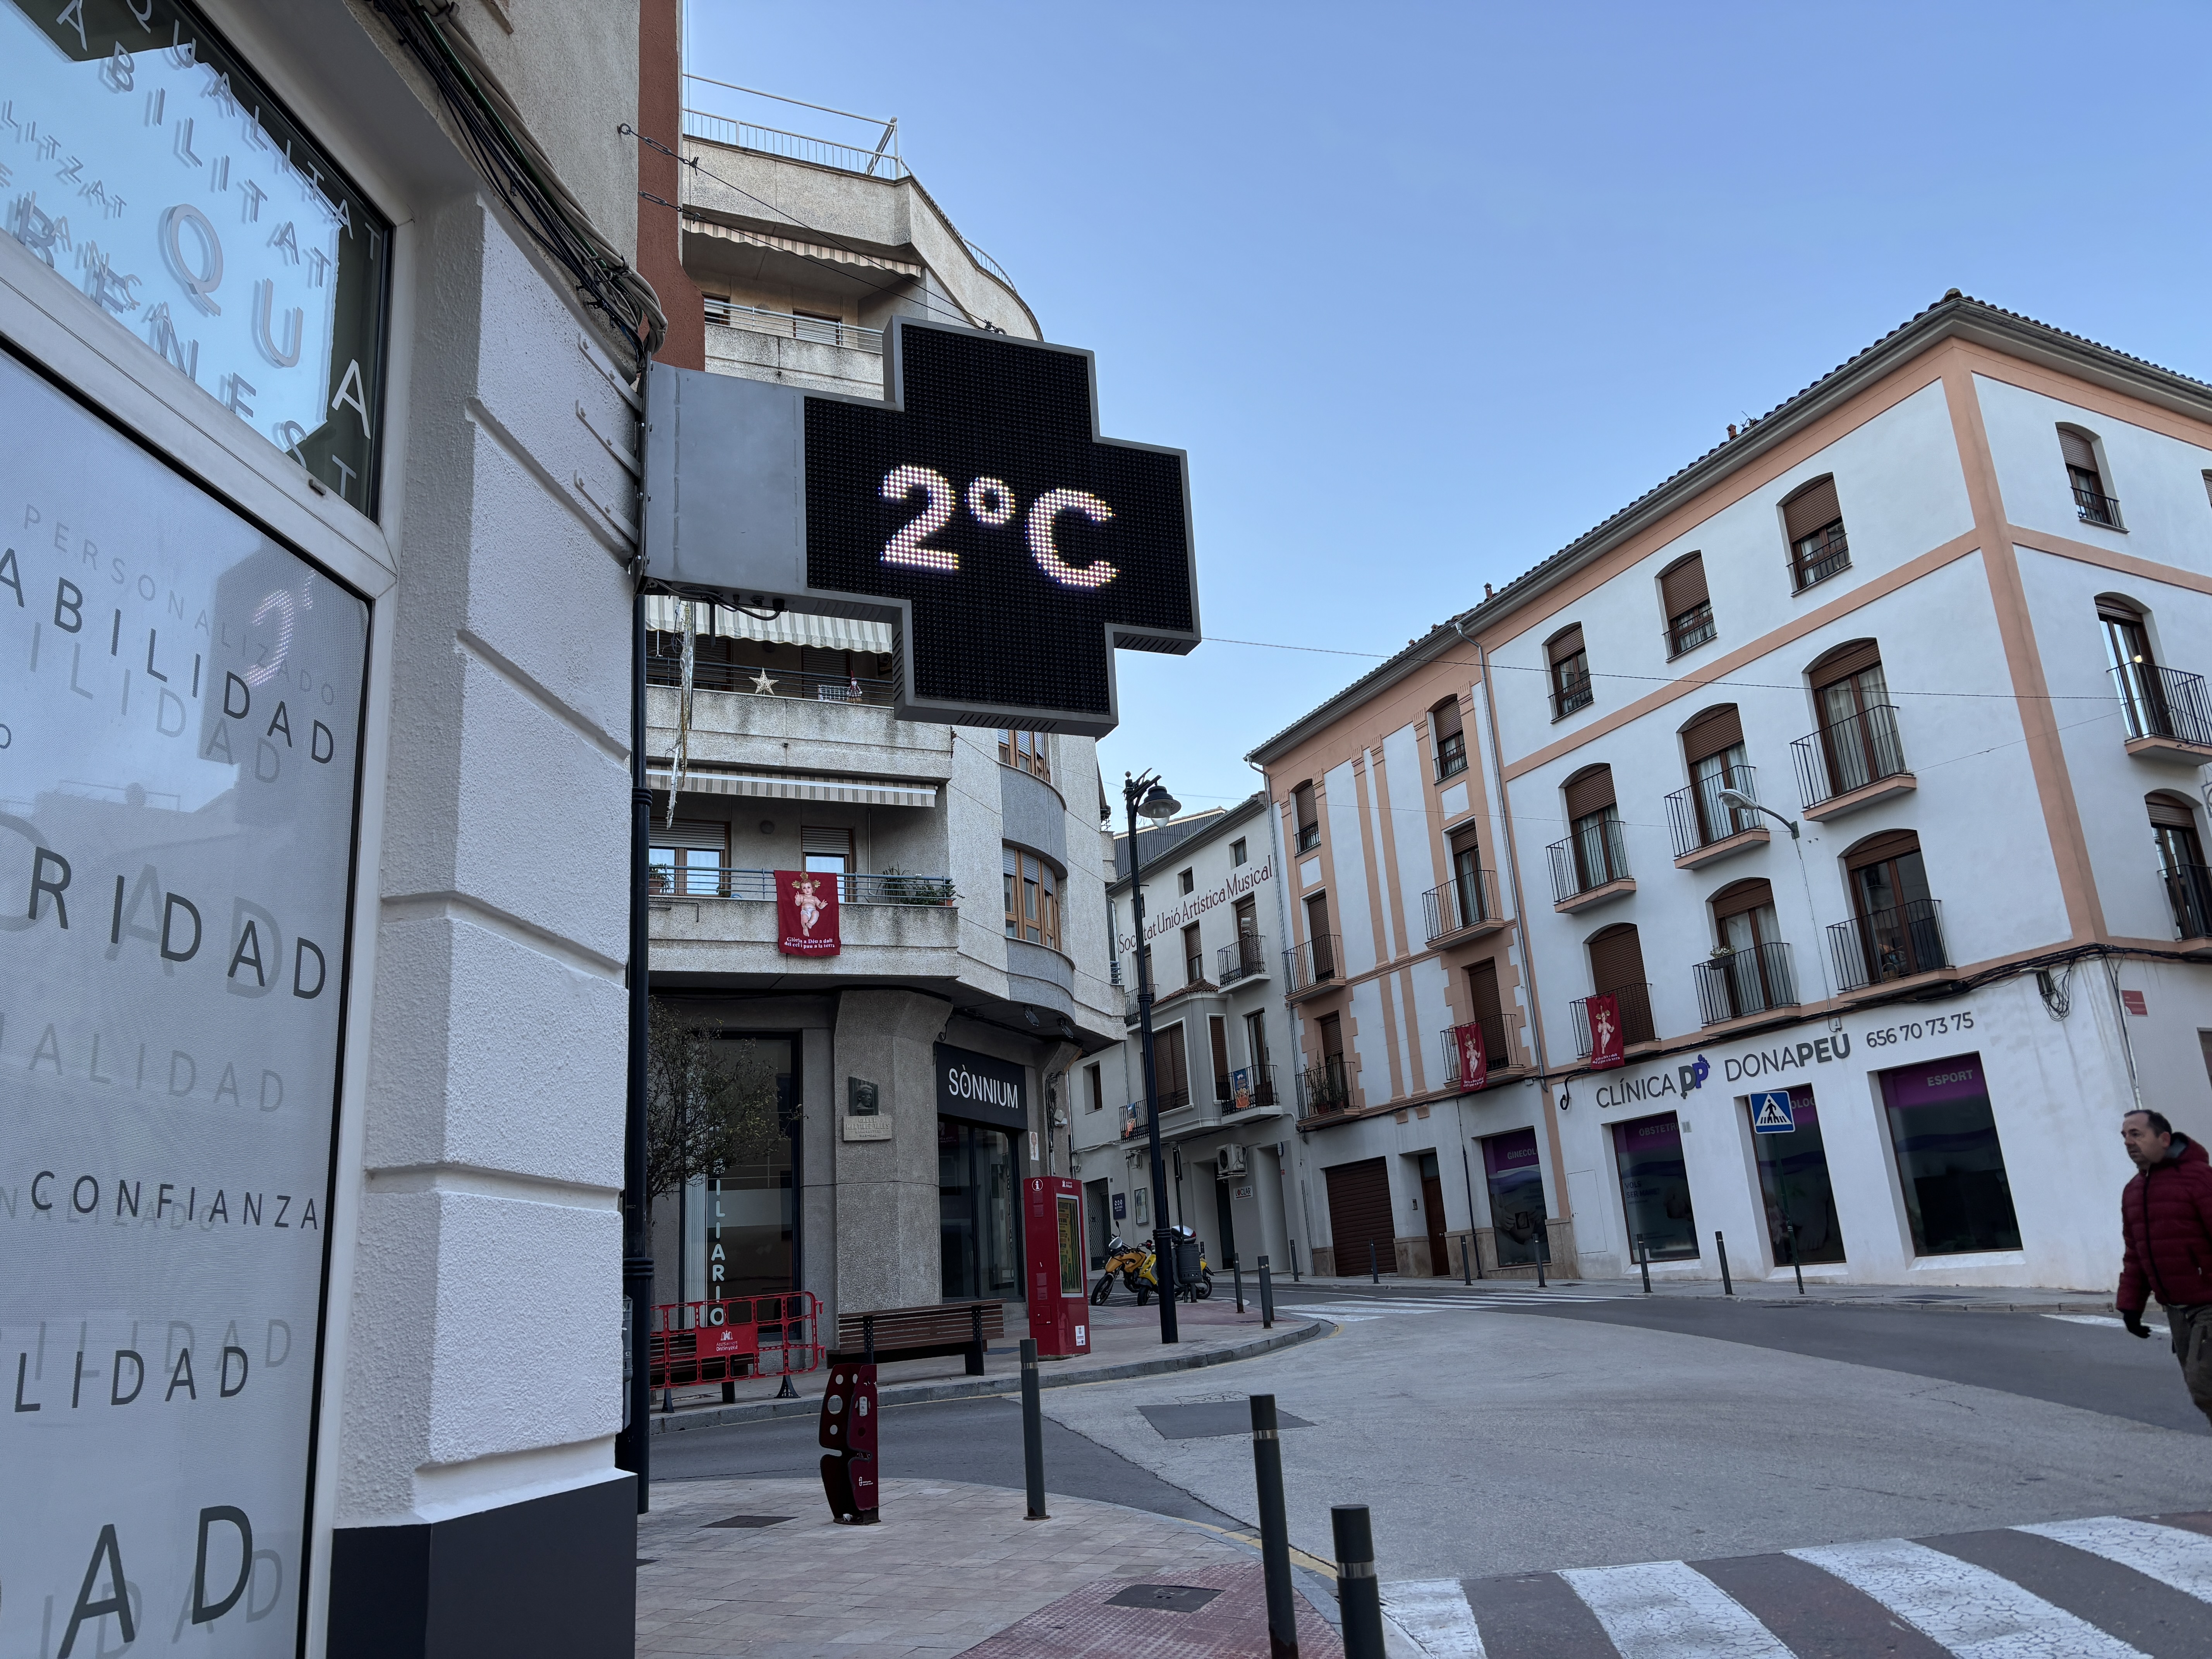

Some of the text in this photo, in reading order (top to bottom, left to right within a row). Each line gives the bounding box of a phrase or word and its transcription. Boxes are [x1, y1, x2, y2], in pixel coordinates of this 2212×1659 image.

[28, 847, 326, 1000] RIDAD
[1119, 855, 1273, 953] Soctat Unió Artística Musical
[0, 1012, 284, 1113] ALIDAD
[1867, 1012, 1974, 1048] 656 70 73 75
[1596, 1073, 1676, 1108] CLÍNICA
[1724, 1033, 1851, 1082] DONAPEU
[1927, 1069, 1973, 1087] ESPORT
[1507, 1147, 1538, 1159] GINECOL
[31, 1170, 318, 1231] CONFIANZA
[15, 1346, 249, 1413] LIDAD
